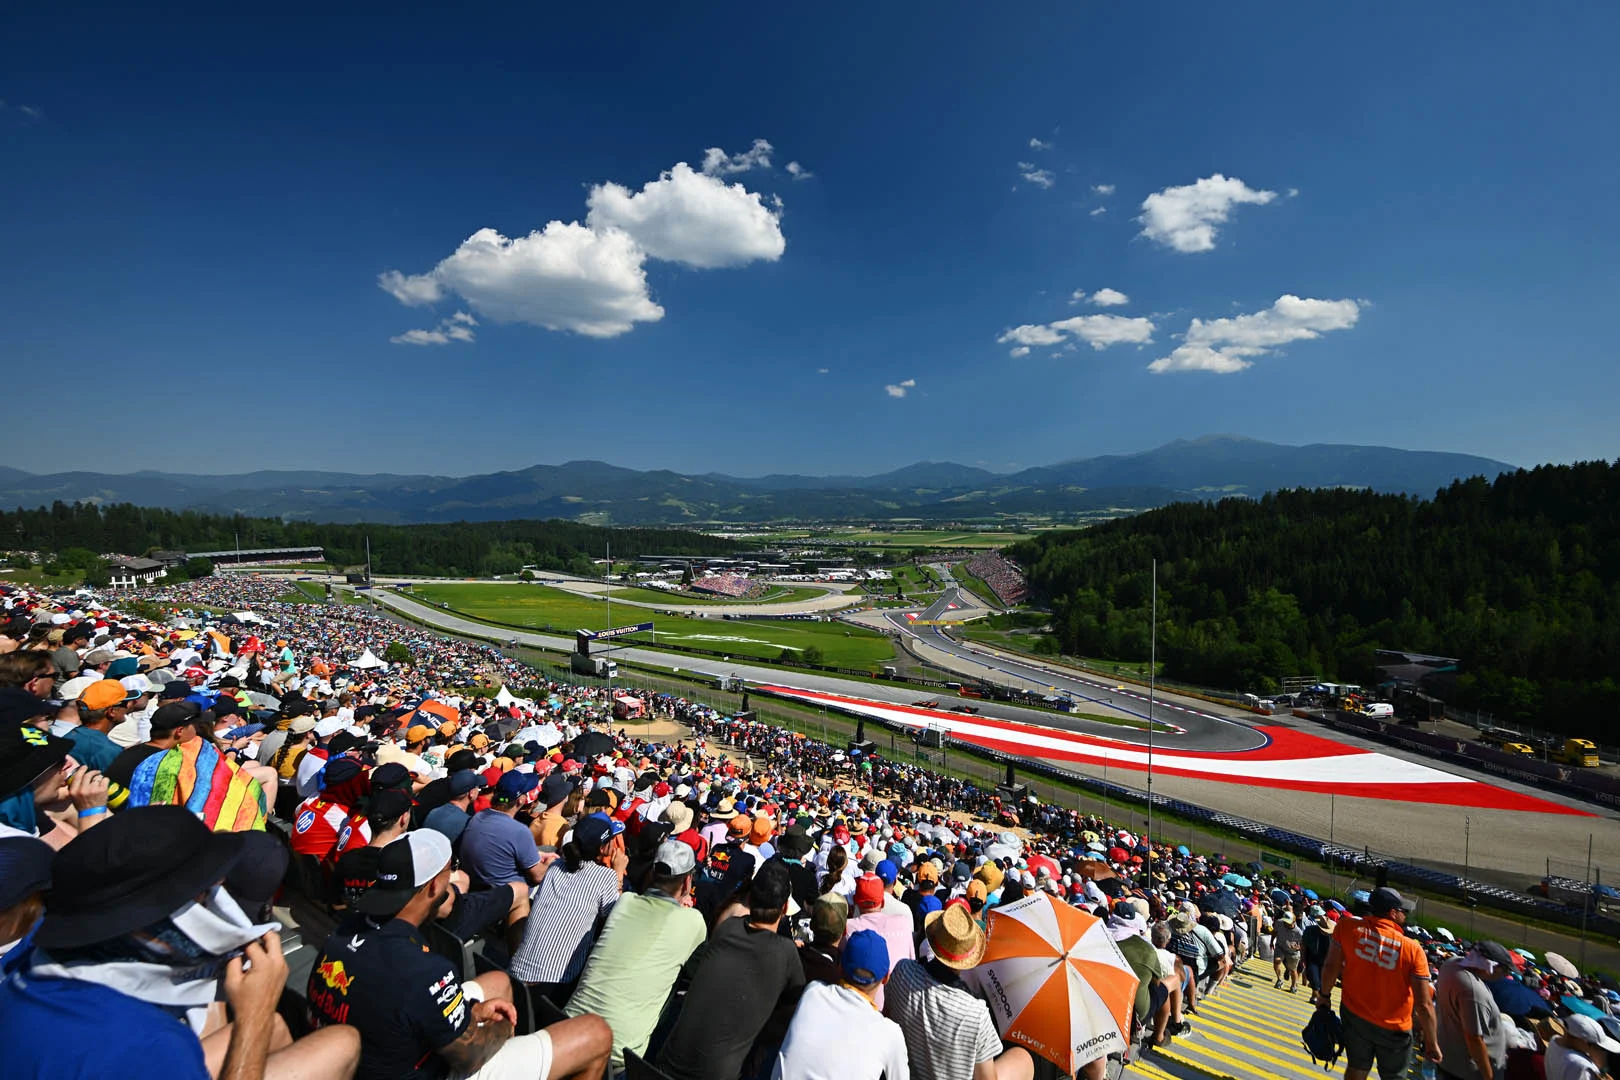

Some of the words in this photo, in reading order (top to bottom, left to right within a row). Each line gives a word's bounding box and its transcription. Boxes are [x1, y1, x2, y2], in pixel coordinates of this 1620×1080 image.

[597, 630, 615, 638] LOUIS
[615, 626, 639, 635] VUITTON
[1355, 937, 1400, 970] 33
[987, 968, 1013, 1019] SWEDOOR
[323, 993, 350, 1025] Bull
[1011, 1030, 1046, 1050] clever
[1076, 1031, 1117, 1054] SWEDOOR
